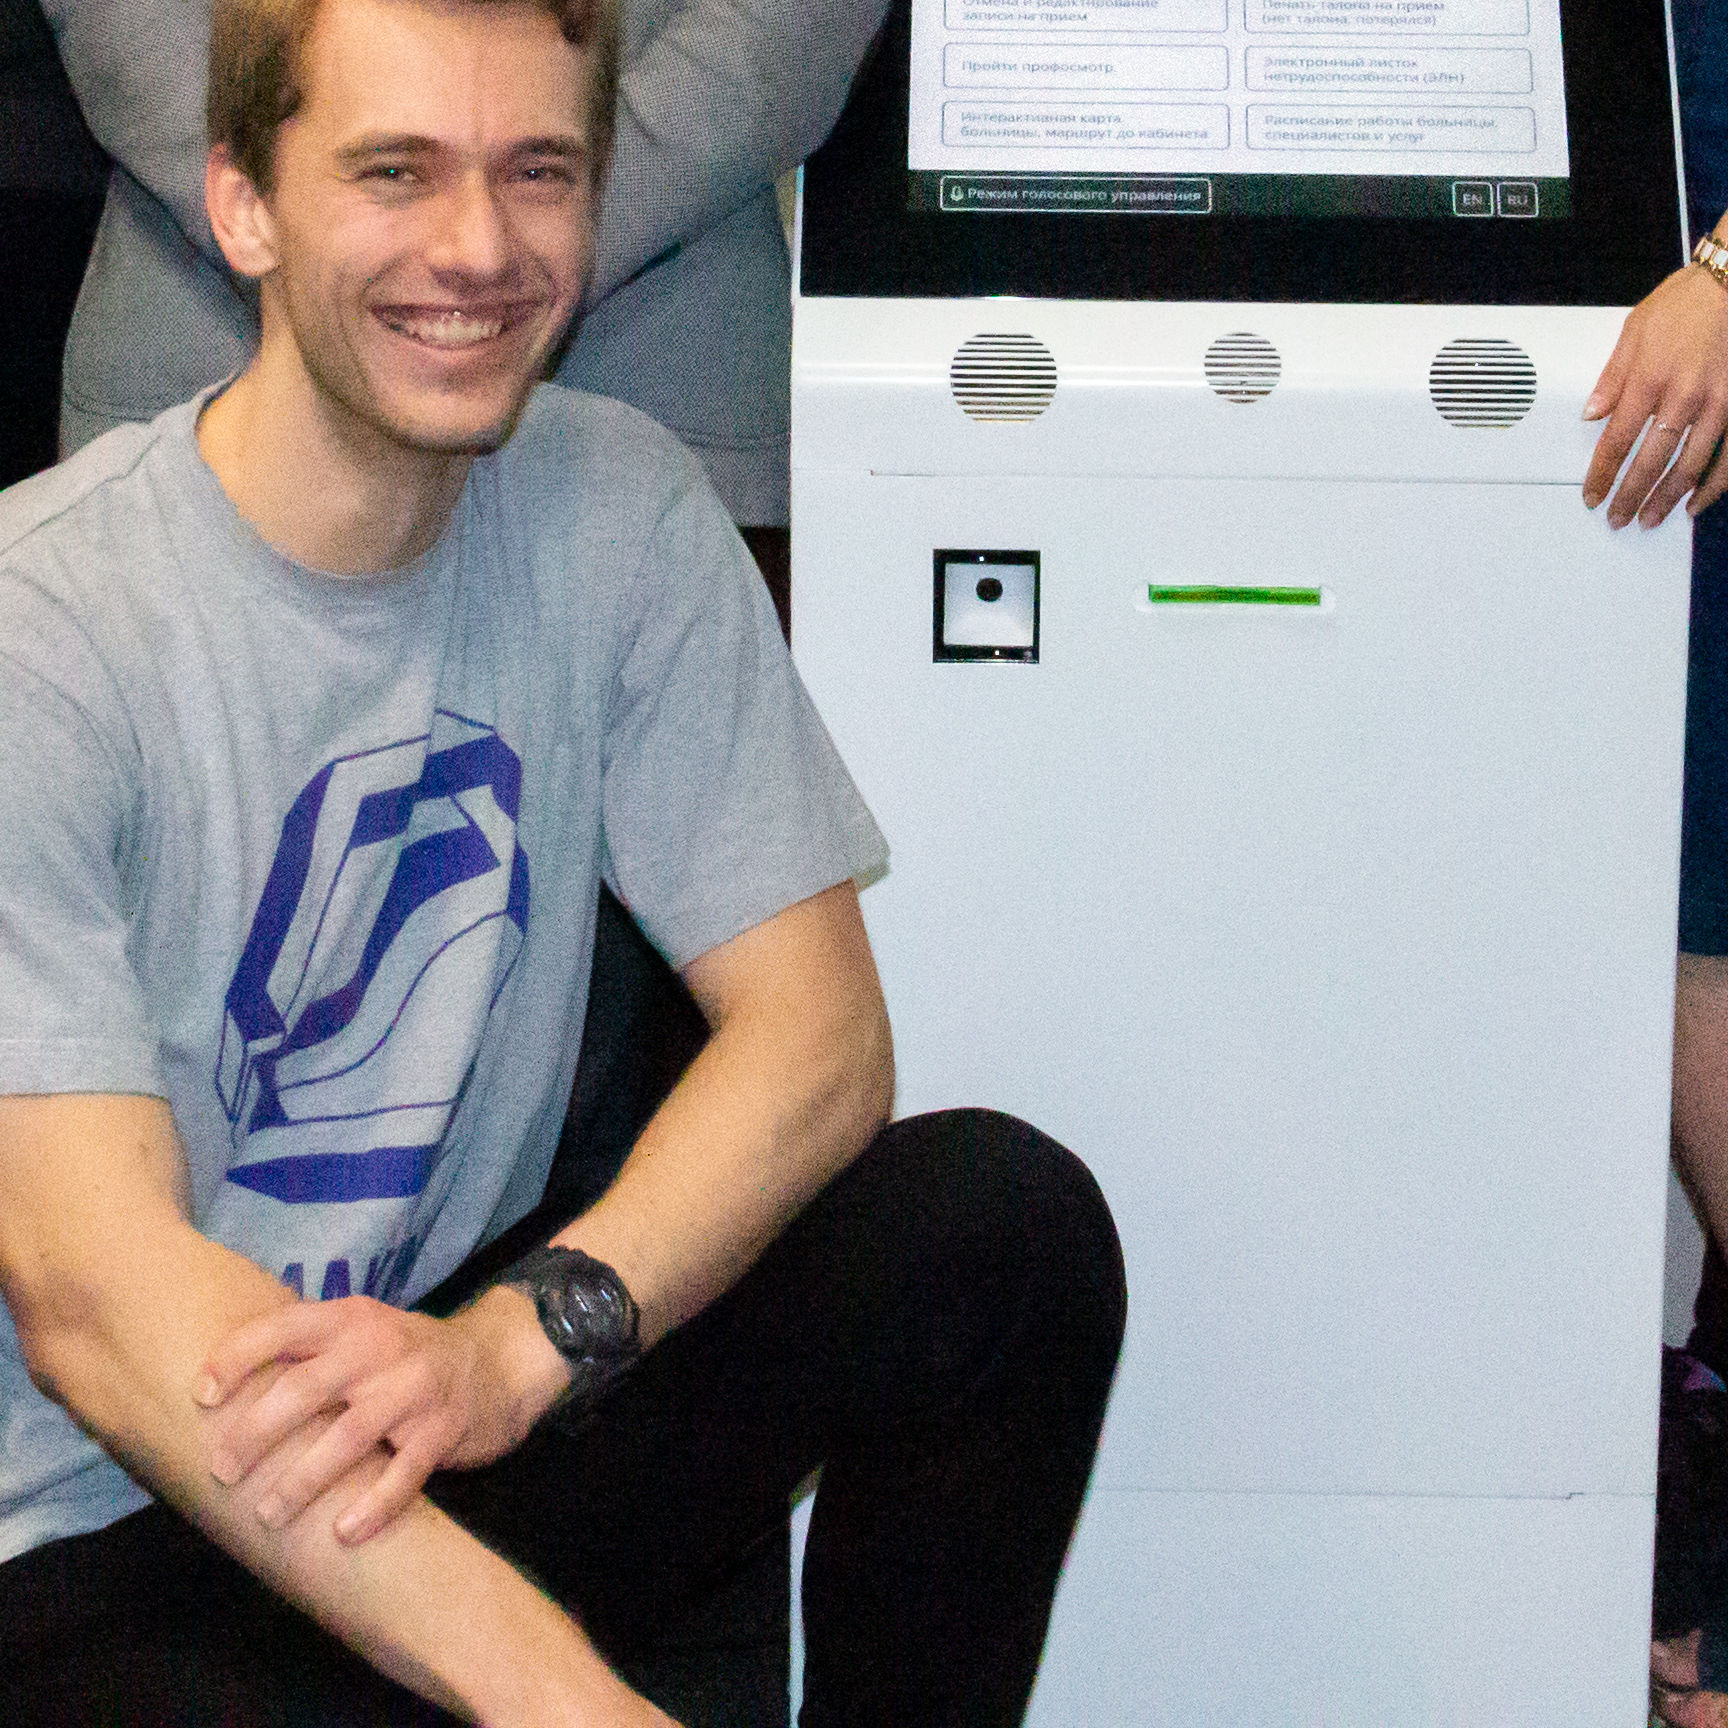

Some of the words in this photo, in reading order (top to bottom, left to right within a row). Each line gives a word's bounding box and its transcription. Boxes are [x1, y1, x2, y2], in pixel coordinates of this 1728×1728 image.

[1036, 0, 1159, 10] редактирование
[1321, 1, 1371, 10] талона
[1375, 2, 1393, 10] на
[962, 12, 1015, 21] записи
[1018, 13, 1036, 21] на
[961, 60, 1018, 73] Пройти
[1021, 61, 1114, 75] профосмотр
[1263, 58, 1365, 69] Электронный
[1368, 59, 1419, 69] листок
[1263, 72, 1420, 84] нетрудоспособности
[960, 111, 1077, 124] Интерактивная
[1080, 113, 1122, 124] карта
[1263, 115, 1353, 127] Расписание
[1357, 115, 1413, 128] работы
[1045, 129, 1113, 140] маршрут
[1116, 129, 1135, 139] до
[1138, 127, 1209, 139] кабинета
[1264, 130, 1373, 142] специалистов
[1387, 131, 1425, 144] услуг
[967, 189, 1018, 200] Режим
[1022, 190, 1107, 201] голосового
[1111, 190, 1203, 204] управления
[1462, 193, 1483, 206] EN
[1506, 194, 1529, 206] RU
